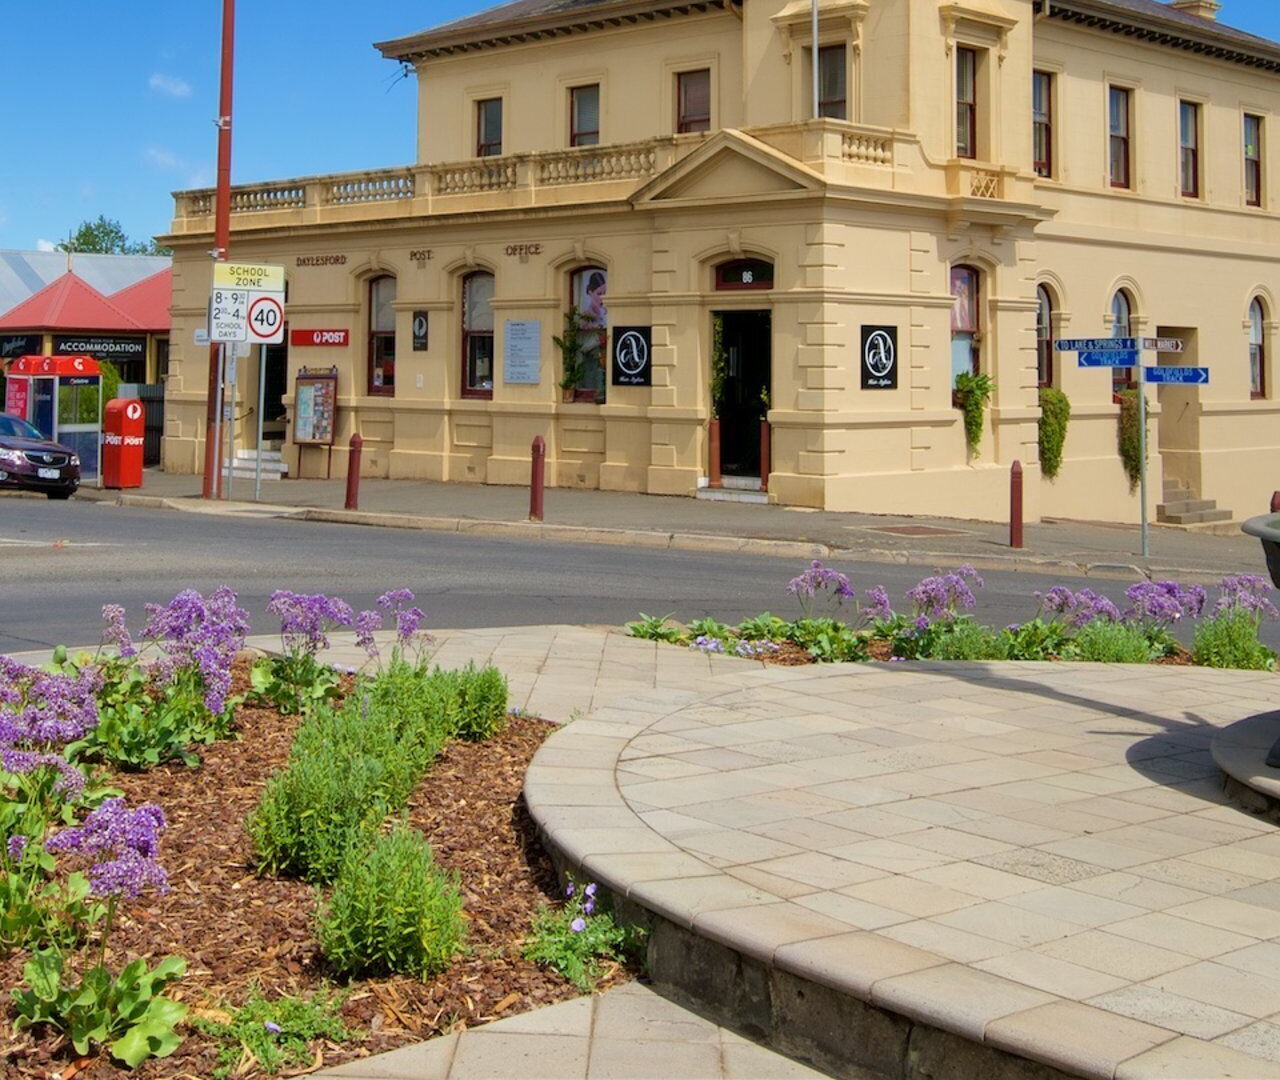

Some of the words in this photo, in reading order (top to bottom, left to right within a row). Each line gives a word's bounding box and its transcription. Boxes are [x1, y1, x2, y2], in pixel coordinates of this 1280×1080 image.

[296, 256, 346, 267] DAYLESFORD
[409, 250, 432, 261] POST
[505, 244, 542, 256] OFFICE
[229, 266, 270, 277] SCHOOL
[742, 270, 753, 283] 86
[235, 277, 263, 287] ZONE
[254, 308, 277, 327] 40
[215, 322, 243, 330] SCHOOL
[321, 332, 346, 344] POST
[59, 342, 142, 353] ACCOMMODATION
[124, 436, 144, 446] POST
